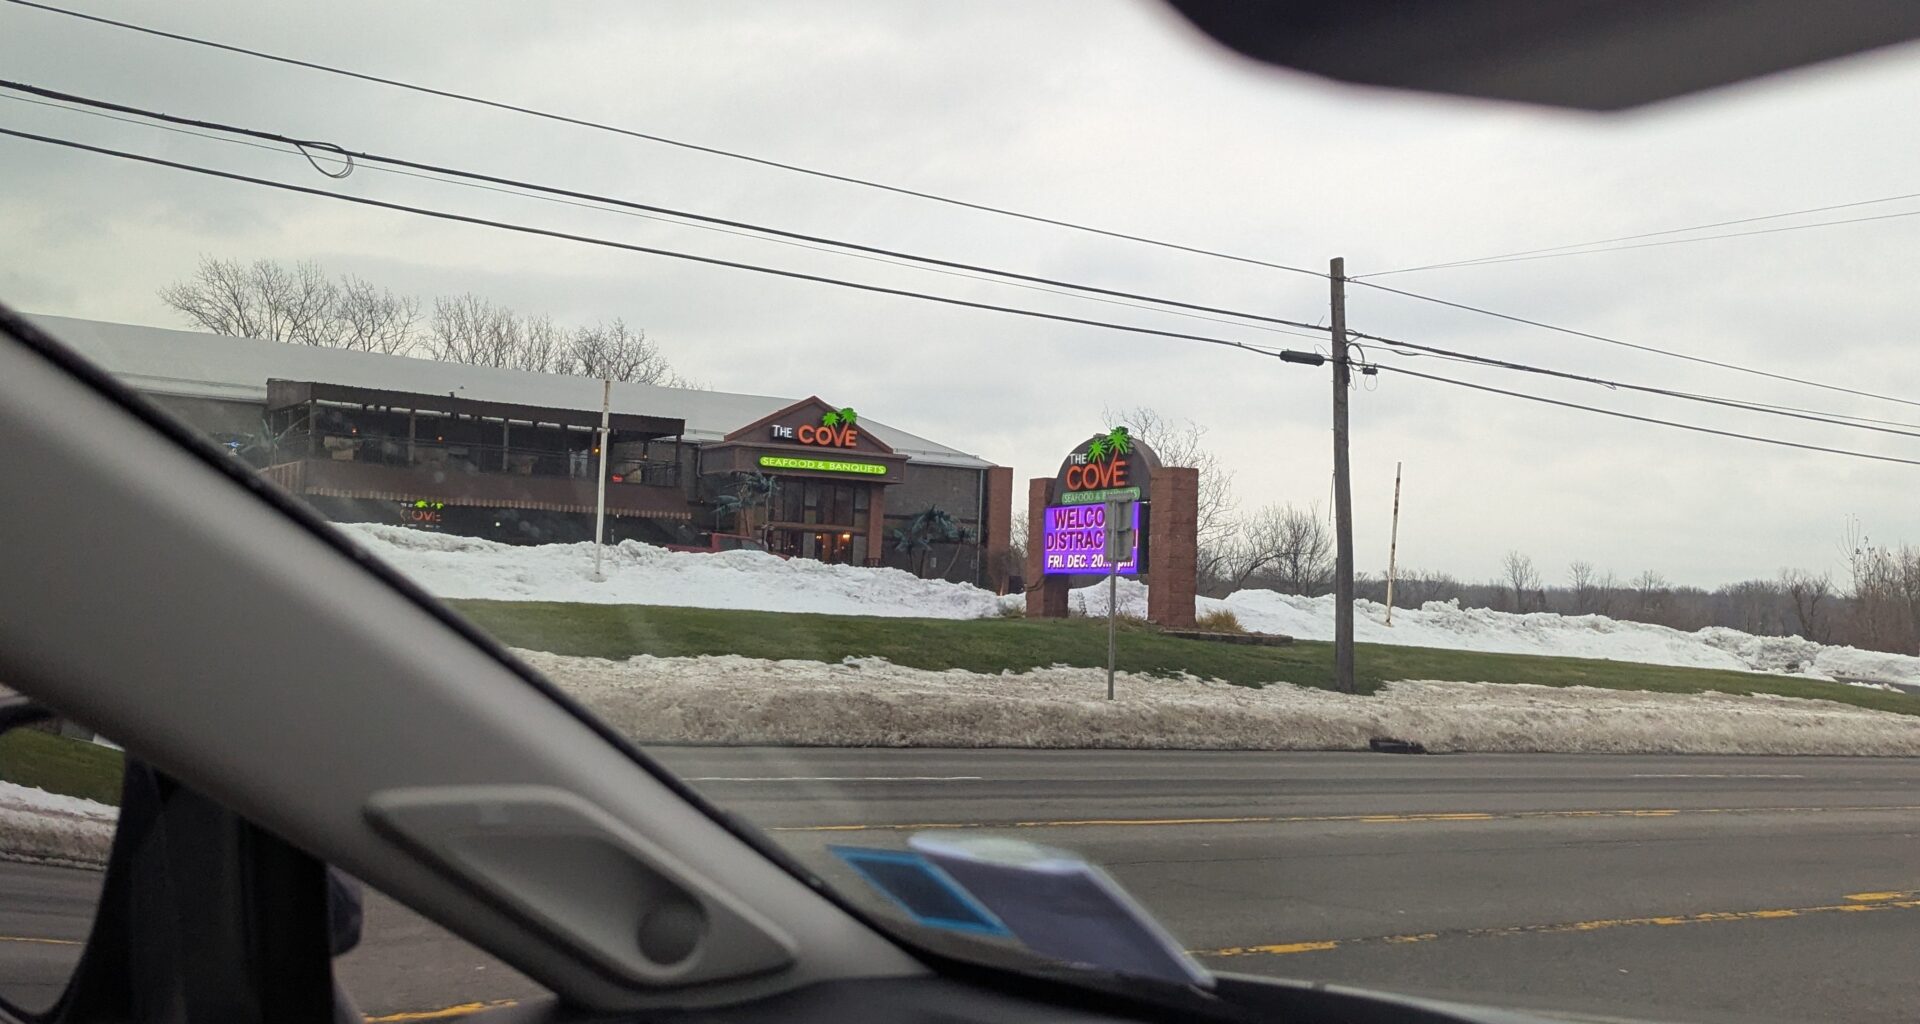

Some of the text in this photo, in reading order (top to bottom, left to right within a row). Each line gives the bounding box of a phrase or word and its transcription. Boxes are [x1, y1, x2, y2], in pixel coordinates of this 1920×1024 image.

[772, 424, 857, 446] THE COVE
[762, 457, 885, 473] SEAFOOD & BANQUETS
[1066, 454, 1126, 491] THE COVE
[1064, 493, 1094, 503] SEAFOOD
[1054, 507, 1105, 530] WELCO
[1046, 531, 1105, 551] DISTRAC
[1048, 555, 1064, 568] FRI.
[1067, 554, 1088, 568] DEC.
